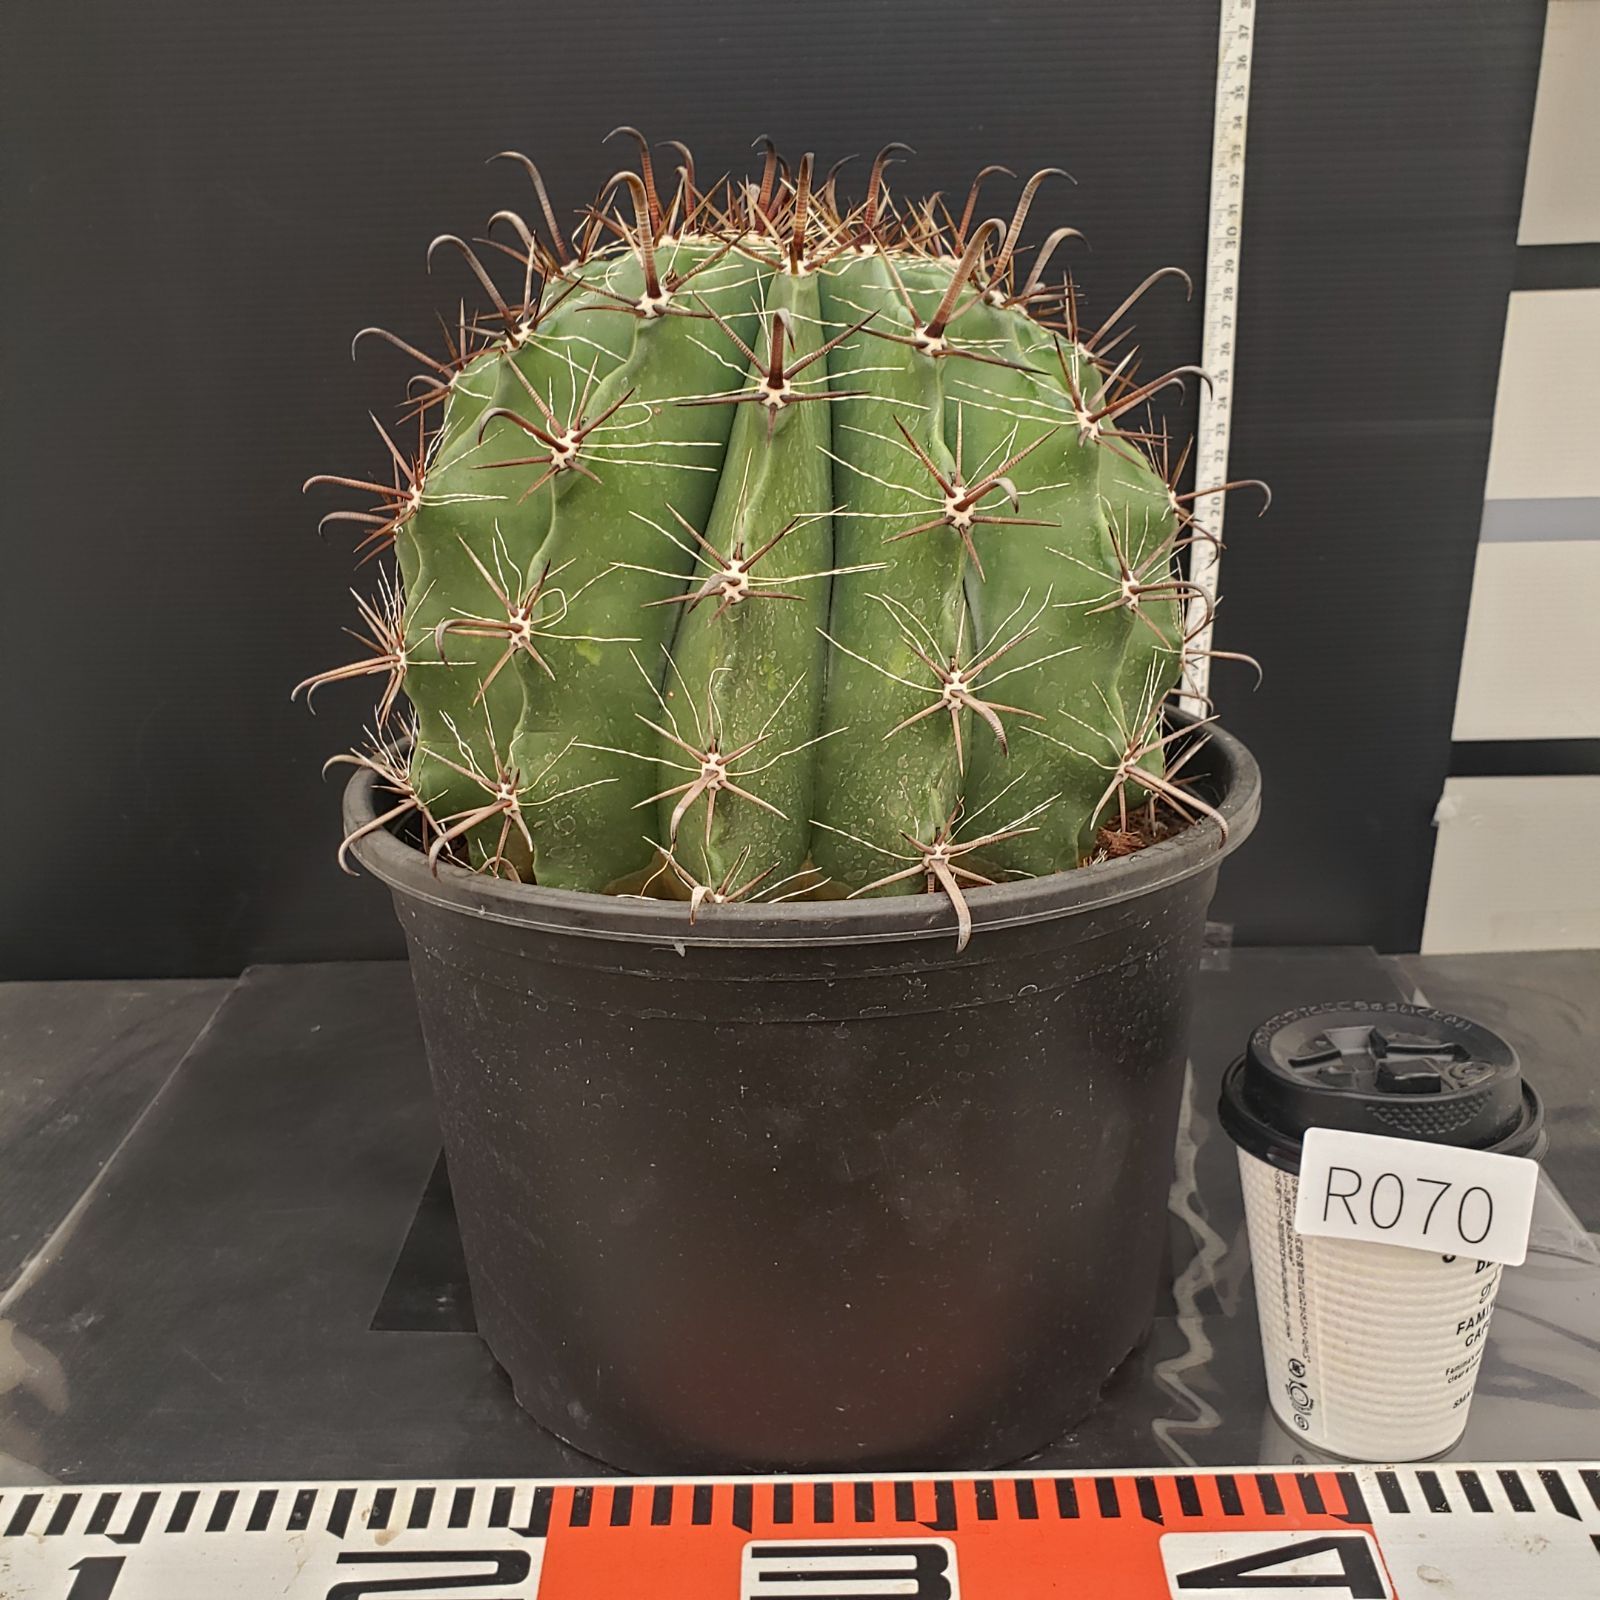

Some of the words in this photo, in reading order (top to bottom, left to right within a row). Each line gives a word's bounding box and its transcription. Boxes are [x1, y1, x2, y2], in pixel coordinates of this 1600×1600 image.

[1239, 24, 1249, 40] 37
[1236, 55, 1248, 70] 36
[1234, 85, 1245, 100] 35
[1232, 115, 1242, 129] 34
[1229, 174, 1239, 188] 32
[1228, 203, 1239, 217] 31
[1225, 226, 1237, 249] 30
[1224, 259, 1234, 273] 29
[1223, 287, 1233, 301] 28
[1221, 315, 1232, 329] 27
[1220, 342, 1230, 356] 26
[1219, 369, 1229, 383] 25
[1217, 396, 1227, 410] 24
[1216, 423, 1226, 436] 23
[1214, 449, 1224, 462] 22
[1210, 496, 1221, 517] 20
[1323, 1166, 1493, 1244] R070
[66, 1556, 127, 1600] 1
[325, 1549, 532, 1600] 2
[750, 1543, 952, 1600] 3
[1176, 1536, 1387, 1600] 4
